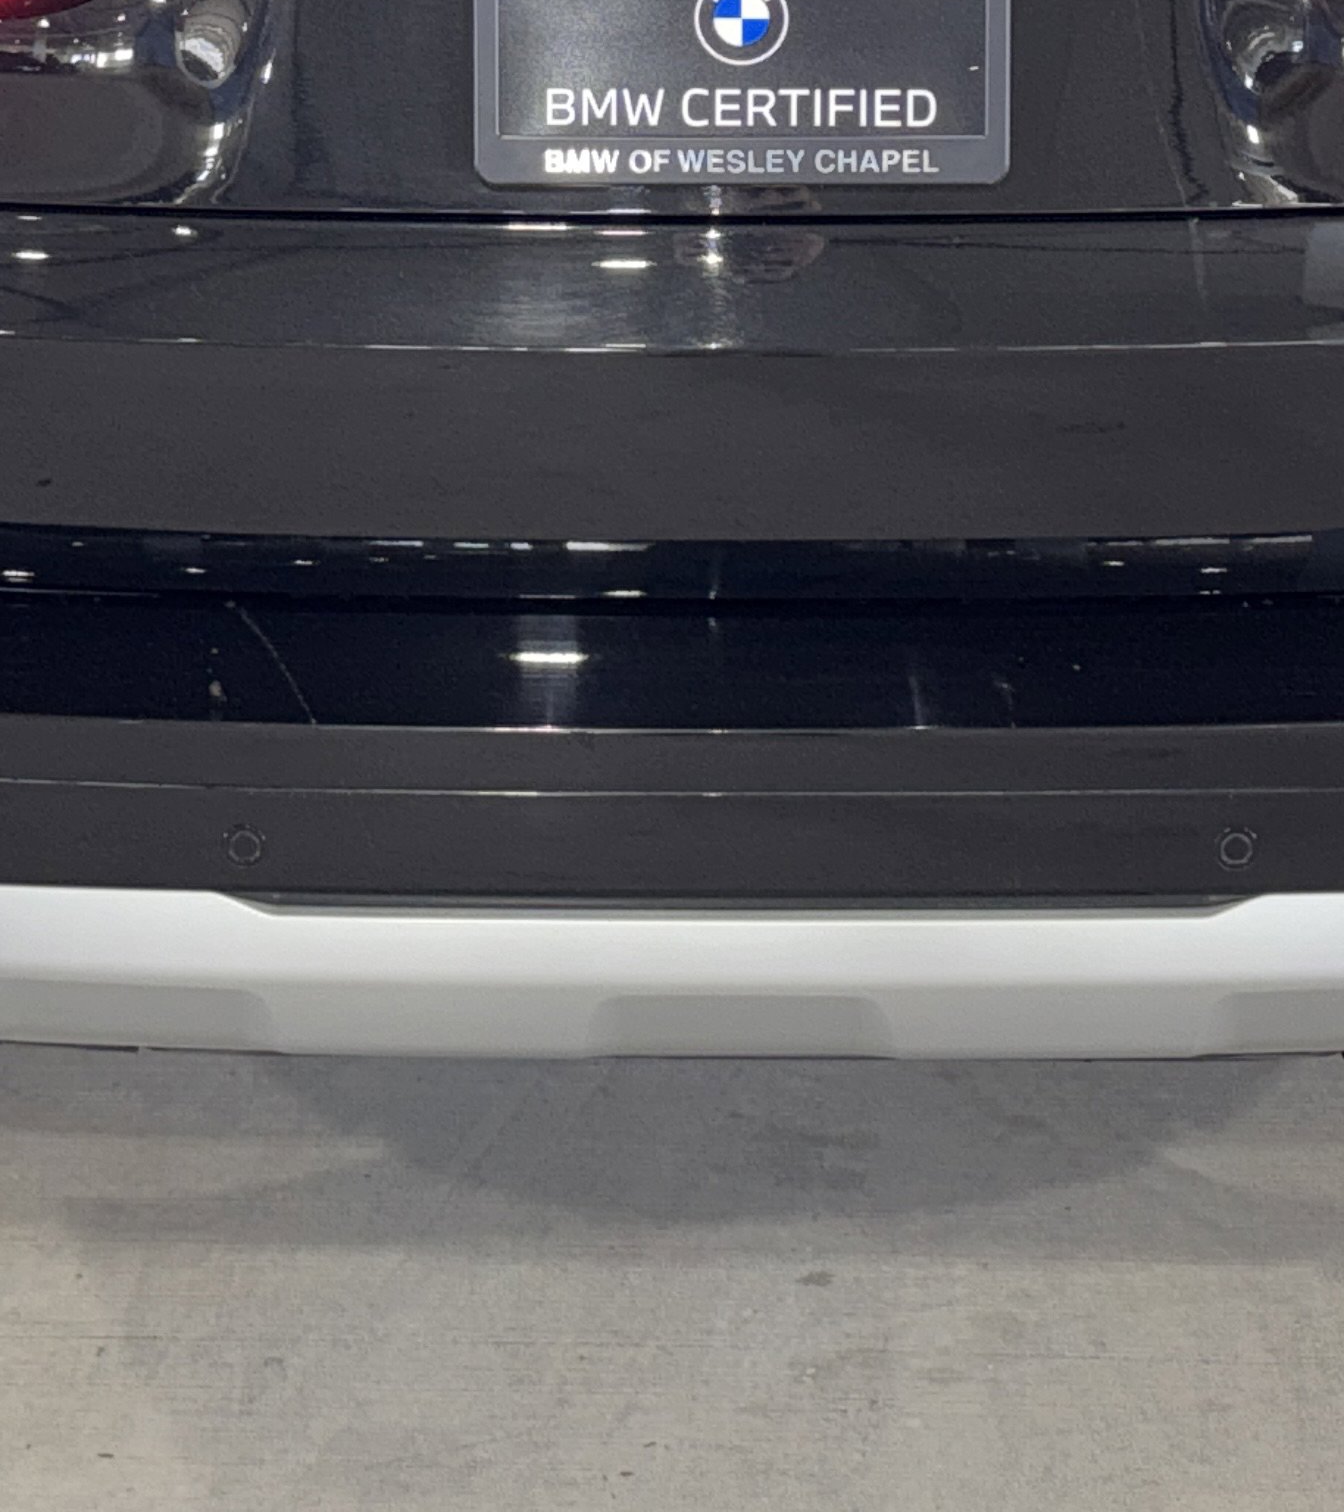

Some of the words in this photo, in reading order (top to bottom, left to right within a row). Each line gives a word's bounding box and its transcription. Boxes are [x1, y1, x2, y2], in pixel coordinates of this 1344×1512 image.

[546, 88, 664, 127] BMW
[681, 88, 938, 127] CERTIFIED
[544, 149, 619, 174] BMW
[629, 149, 671, 174] OF
[678, 149, 805, 174] WESLEY
[814, 149, 939, 174] CHAPEL
